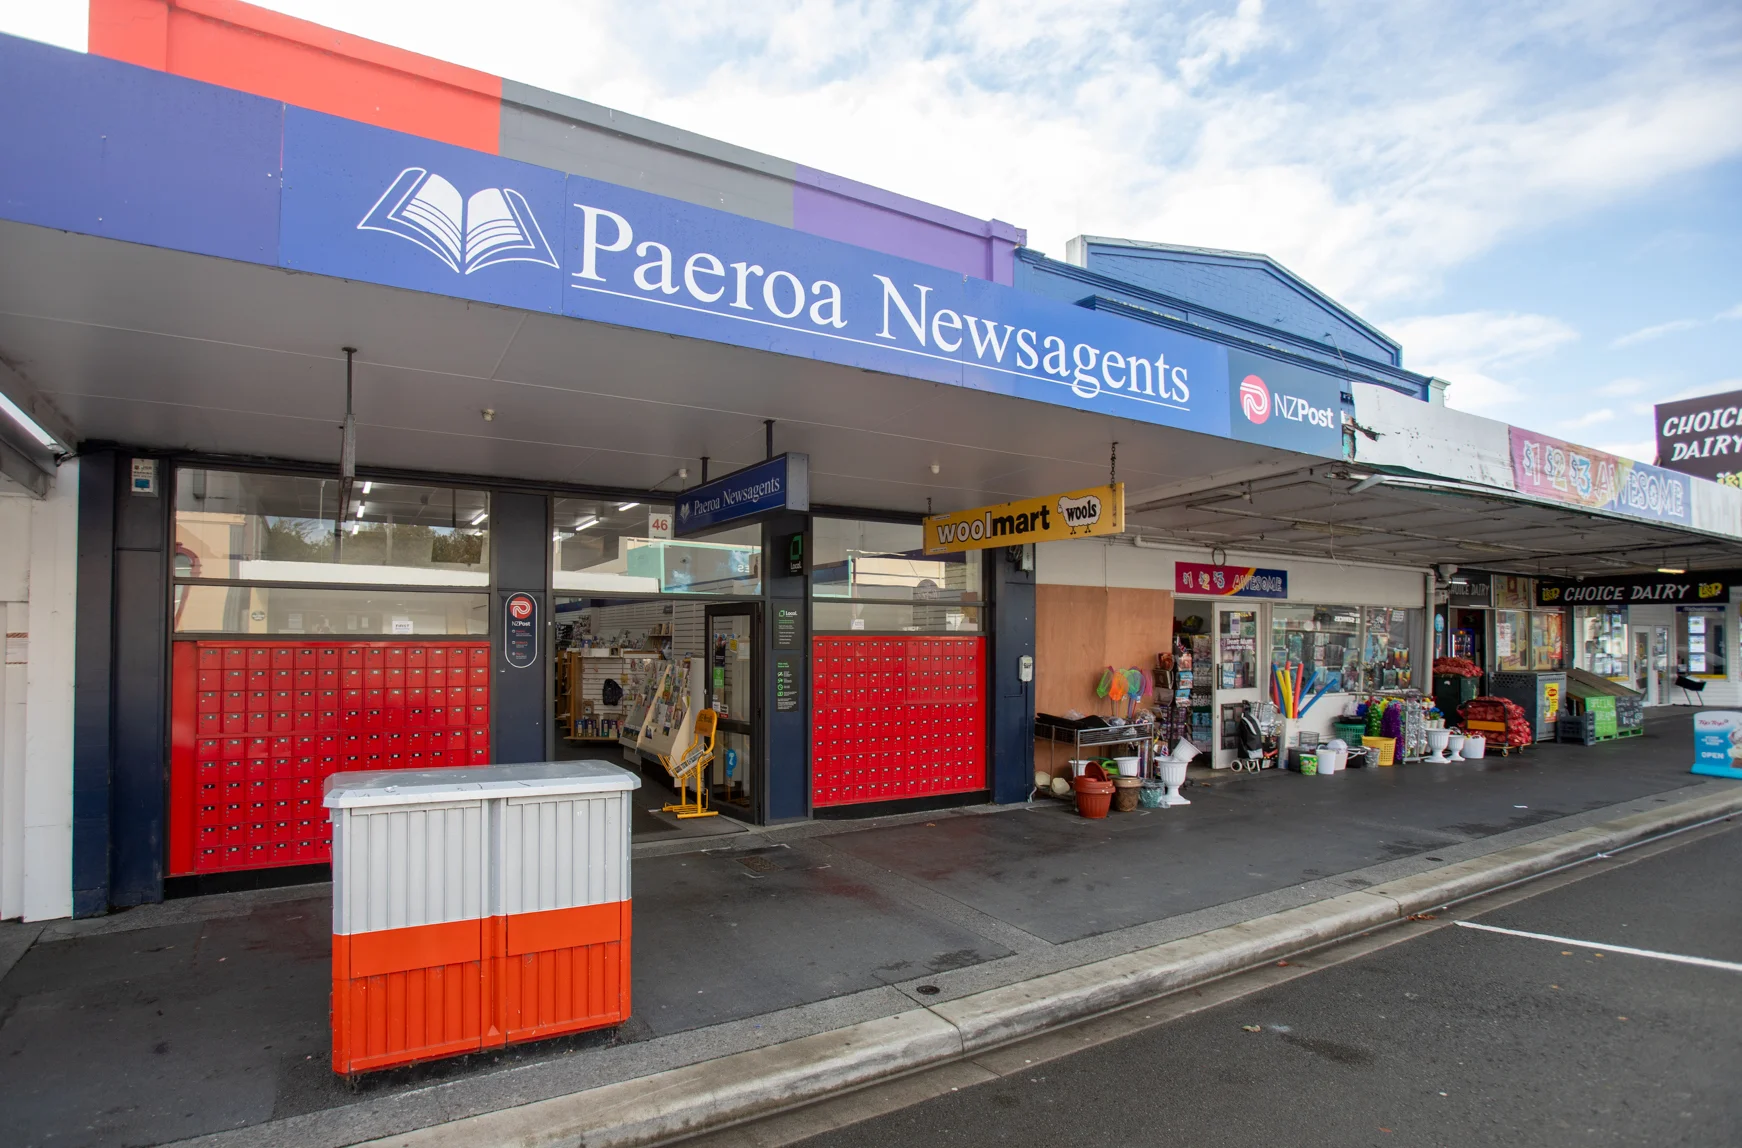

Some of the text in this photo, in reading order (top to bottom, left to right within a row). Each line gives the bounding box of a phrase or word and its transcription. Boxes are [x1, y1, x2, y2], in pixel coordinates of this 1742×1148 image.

[571, 203, 1190, 403] Paeroa Newsagents
[1274, 392, 1335, 429] NZPost
[1670, 434, 1742, 462] DAIRY
[693, 476, 780, 516] Paeroa Newsagents
[1594, 460, 1684, 518] AWESOME
[652, 518, 668, 531] 46
[937, 504, 1050, 545] woolmart
[1232, 573, 1283, 592] AWESOME
[1564, 583, 1690, 602] CHOICE DAIRY
[1701, 751, 1725, 760] OPEN
